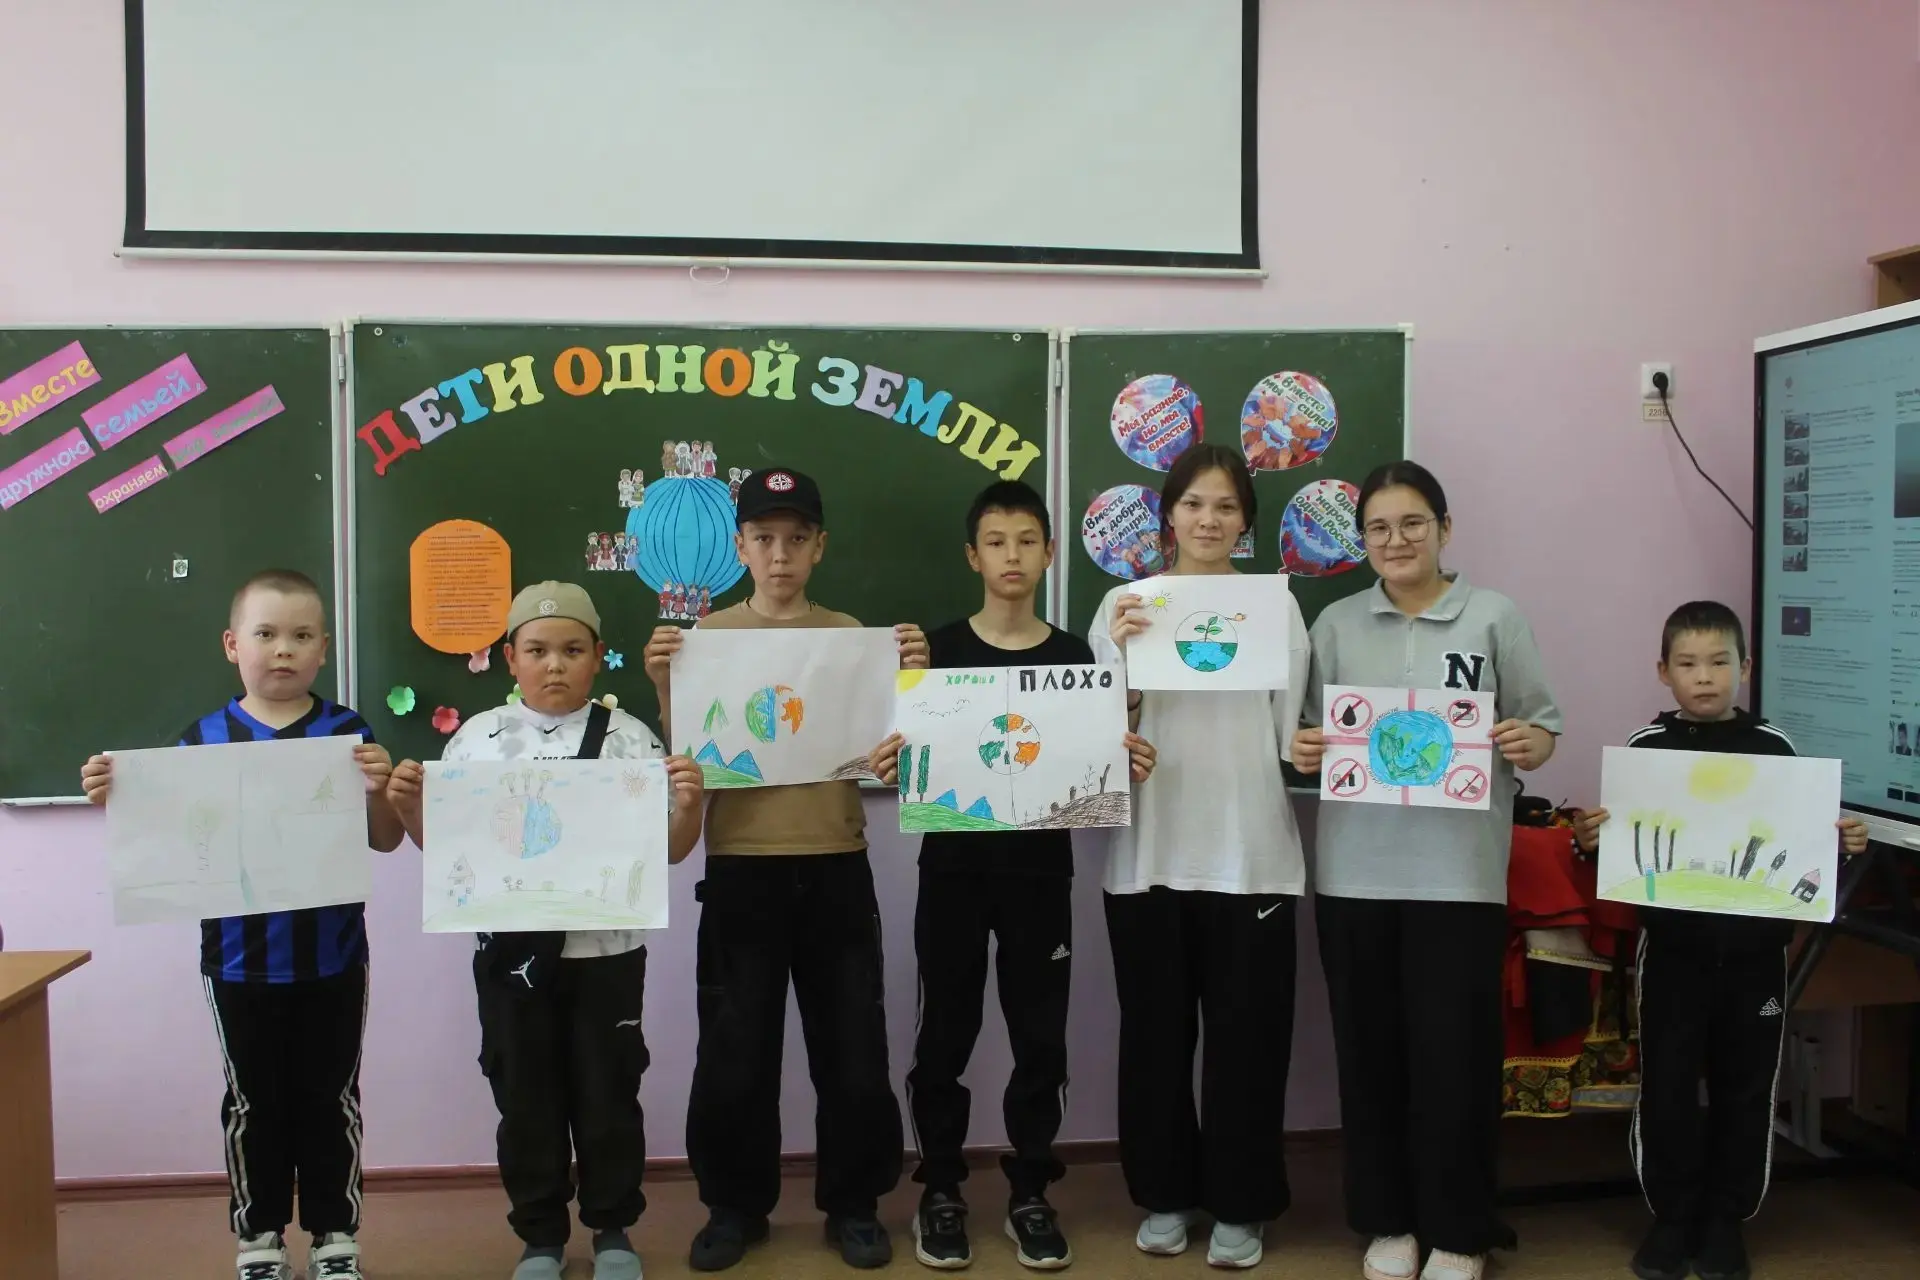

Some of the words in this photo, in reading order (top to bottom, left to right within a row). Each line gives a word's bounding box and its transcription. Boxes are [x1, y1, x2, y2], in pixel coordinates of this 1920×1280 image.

[357, 355, 544, 476] ДЕТИ
[554, 339, 800, 400] ОДНОЙ
[811, 356, 1041, 481] ЗЕМЛИ
[1118, 420, 1140, 437] Мы
[1141, 387, 1189, 424] разные,
[1281, 376, 1325, 412] Вместе
[1142, 424, 1159, 439] но
[1160, 410, 1181, 427] мы
[1148, 416, 1191, 452] вместе!
[1297, 403, 1334, 429] сила!
[0, 440, 91, 505] дружною
[95, 464, 169, 509] охраняем
[1085, 494, 1126, 530] Вместе
[1098, 526, 1108, 538] к
[1109, 498, 1143, 531] добру
[1107, 537, 1118, 548] и
[1118, 506, 1151, 540] миру!
[1295, 496, 1323, 523] одна
[1323, 519, 1368, 560] Россия!
[1315, 495, 1352, 530] народ
[1019, 668, 1113, 693] ПЛОХО
[1443, 652, 1486, 691] N
